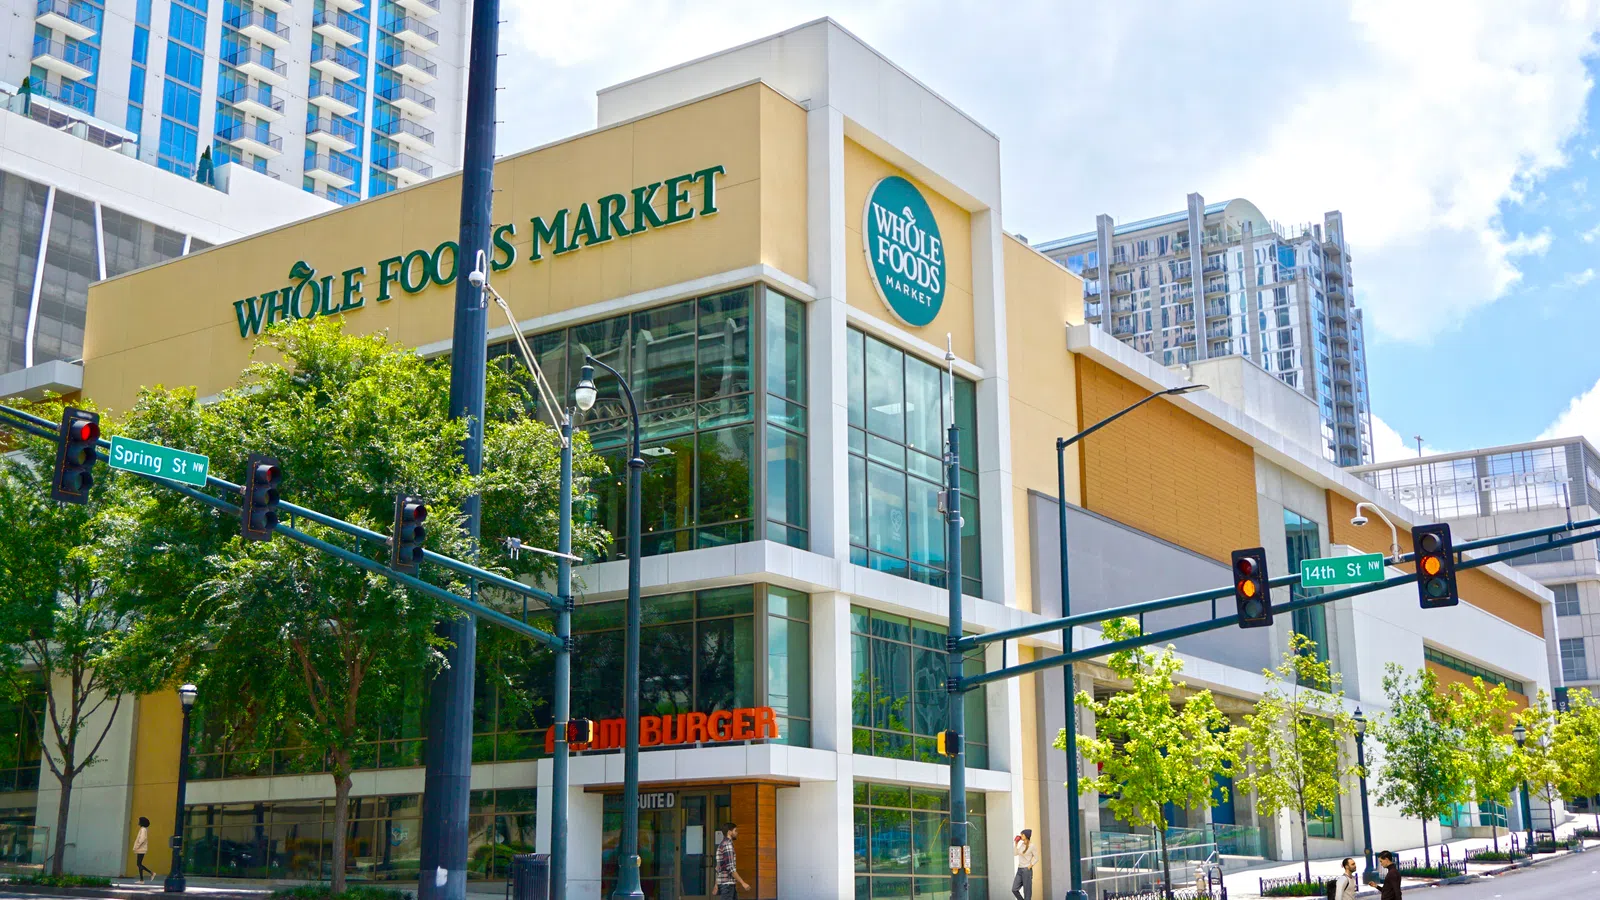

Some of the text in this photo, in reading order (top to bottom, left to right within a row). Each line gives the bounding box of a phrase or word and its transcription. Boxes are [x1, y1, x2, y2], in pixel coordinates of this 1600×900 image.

[233, 165, 726, 338] WHOLE FOOS MARKET
[873, 202, 941, 265] WHOLE
[877, 235, 940, 294] FOODS
[886, 274, 932, 307] MARKET
[114, 444, 205, 475] Spring St NW
[1305, 560, 1380, 580] 14th St NW
[639, 706, 779, 747] BURGER
[636, 792, 675, 809] UITE D
